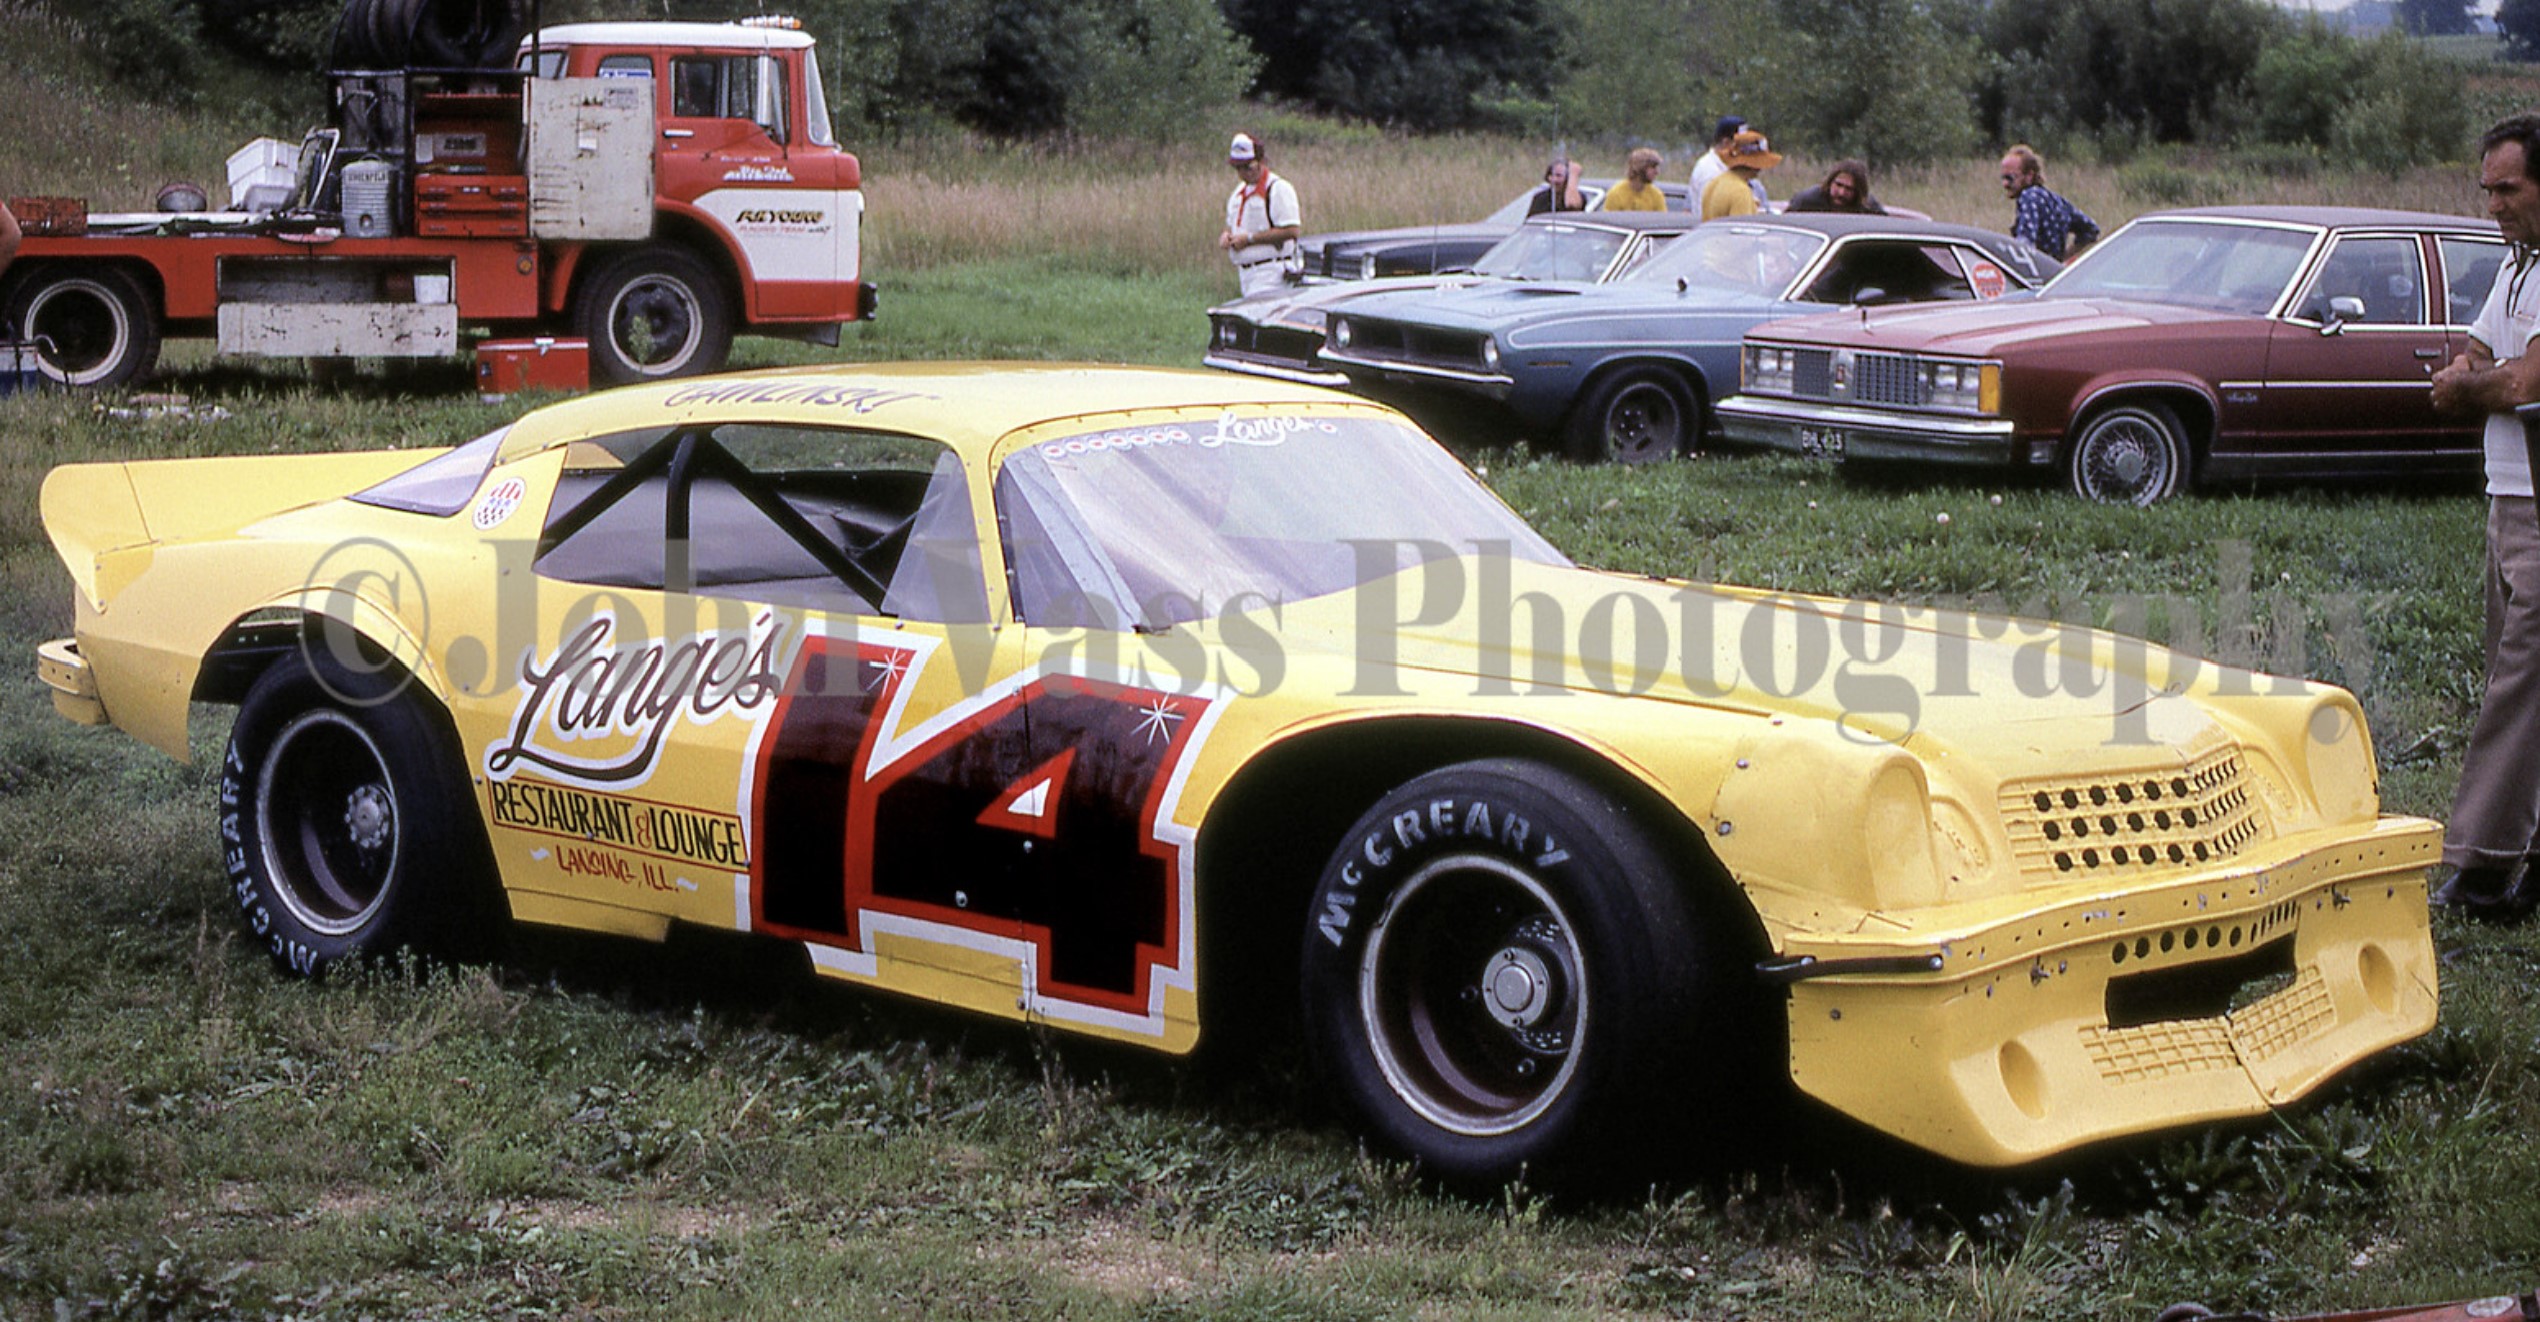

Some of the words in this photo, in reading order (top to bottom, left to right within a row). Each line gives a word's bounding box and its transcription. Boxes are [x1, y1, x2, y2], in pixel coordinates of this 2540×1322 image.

[486, 608, 782, 784] Lange's
[492, 780, 632, 846] RESTAURANT
[649, 807, 746, 866] LOUNGE
[642, 864, 681, 893] ILL.
[750, 635, 1213, 1017] 14
